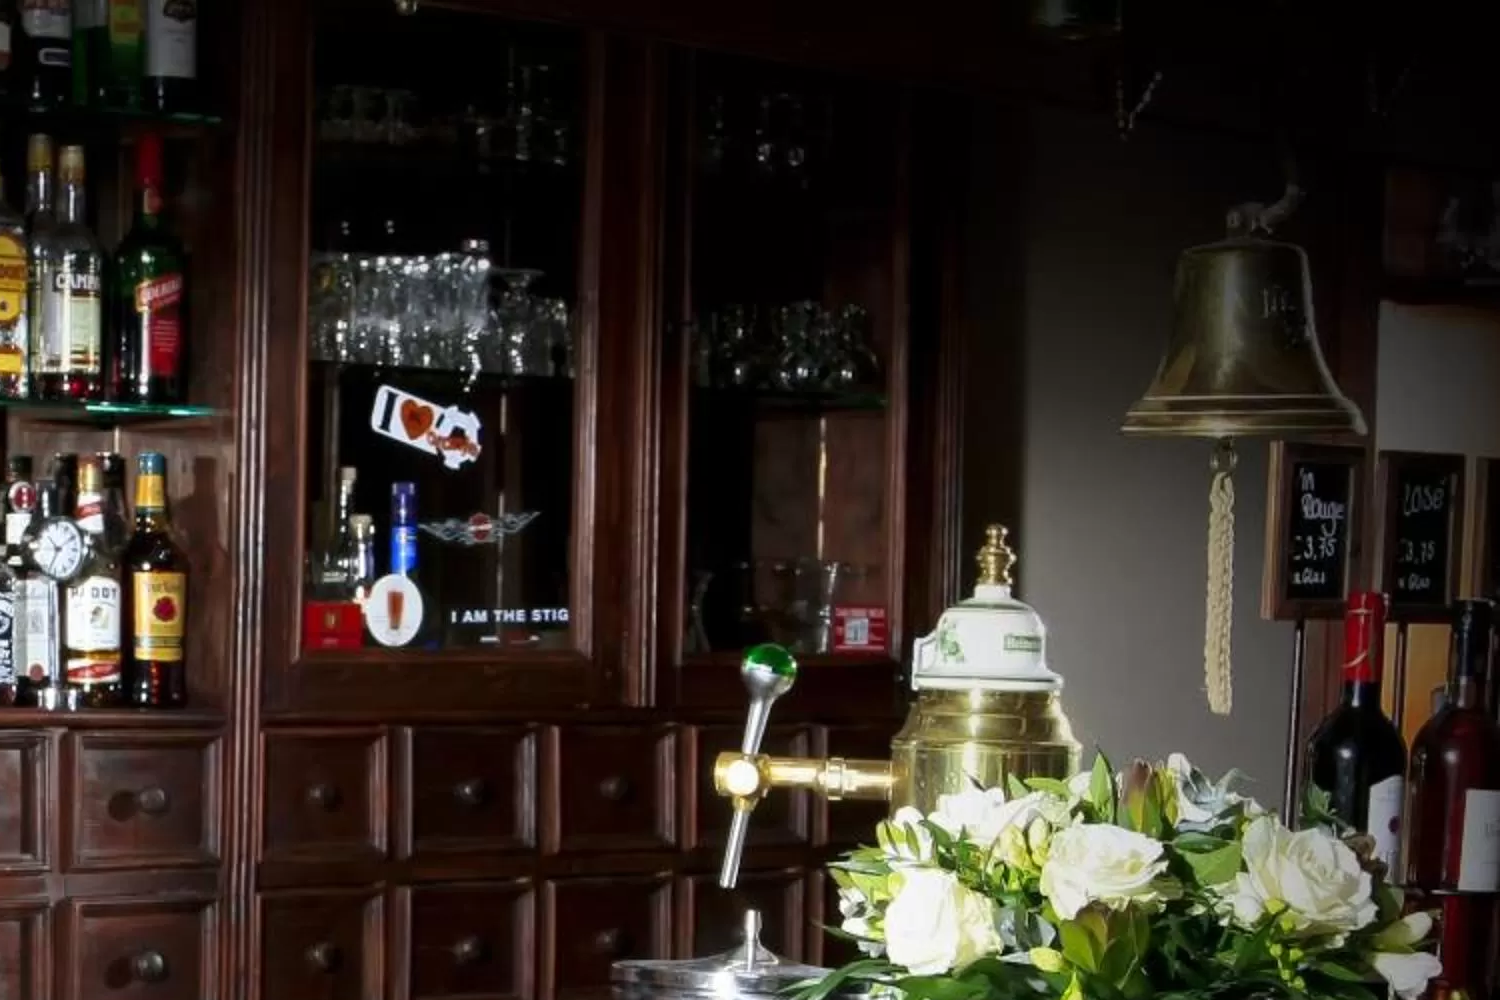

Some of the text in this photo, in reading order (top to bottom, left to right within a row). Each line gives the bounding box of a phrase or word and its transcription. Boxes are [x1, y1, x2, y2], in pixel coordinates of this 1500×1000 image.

[451, 608, 569, 623] I AM THE STIG
